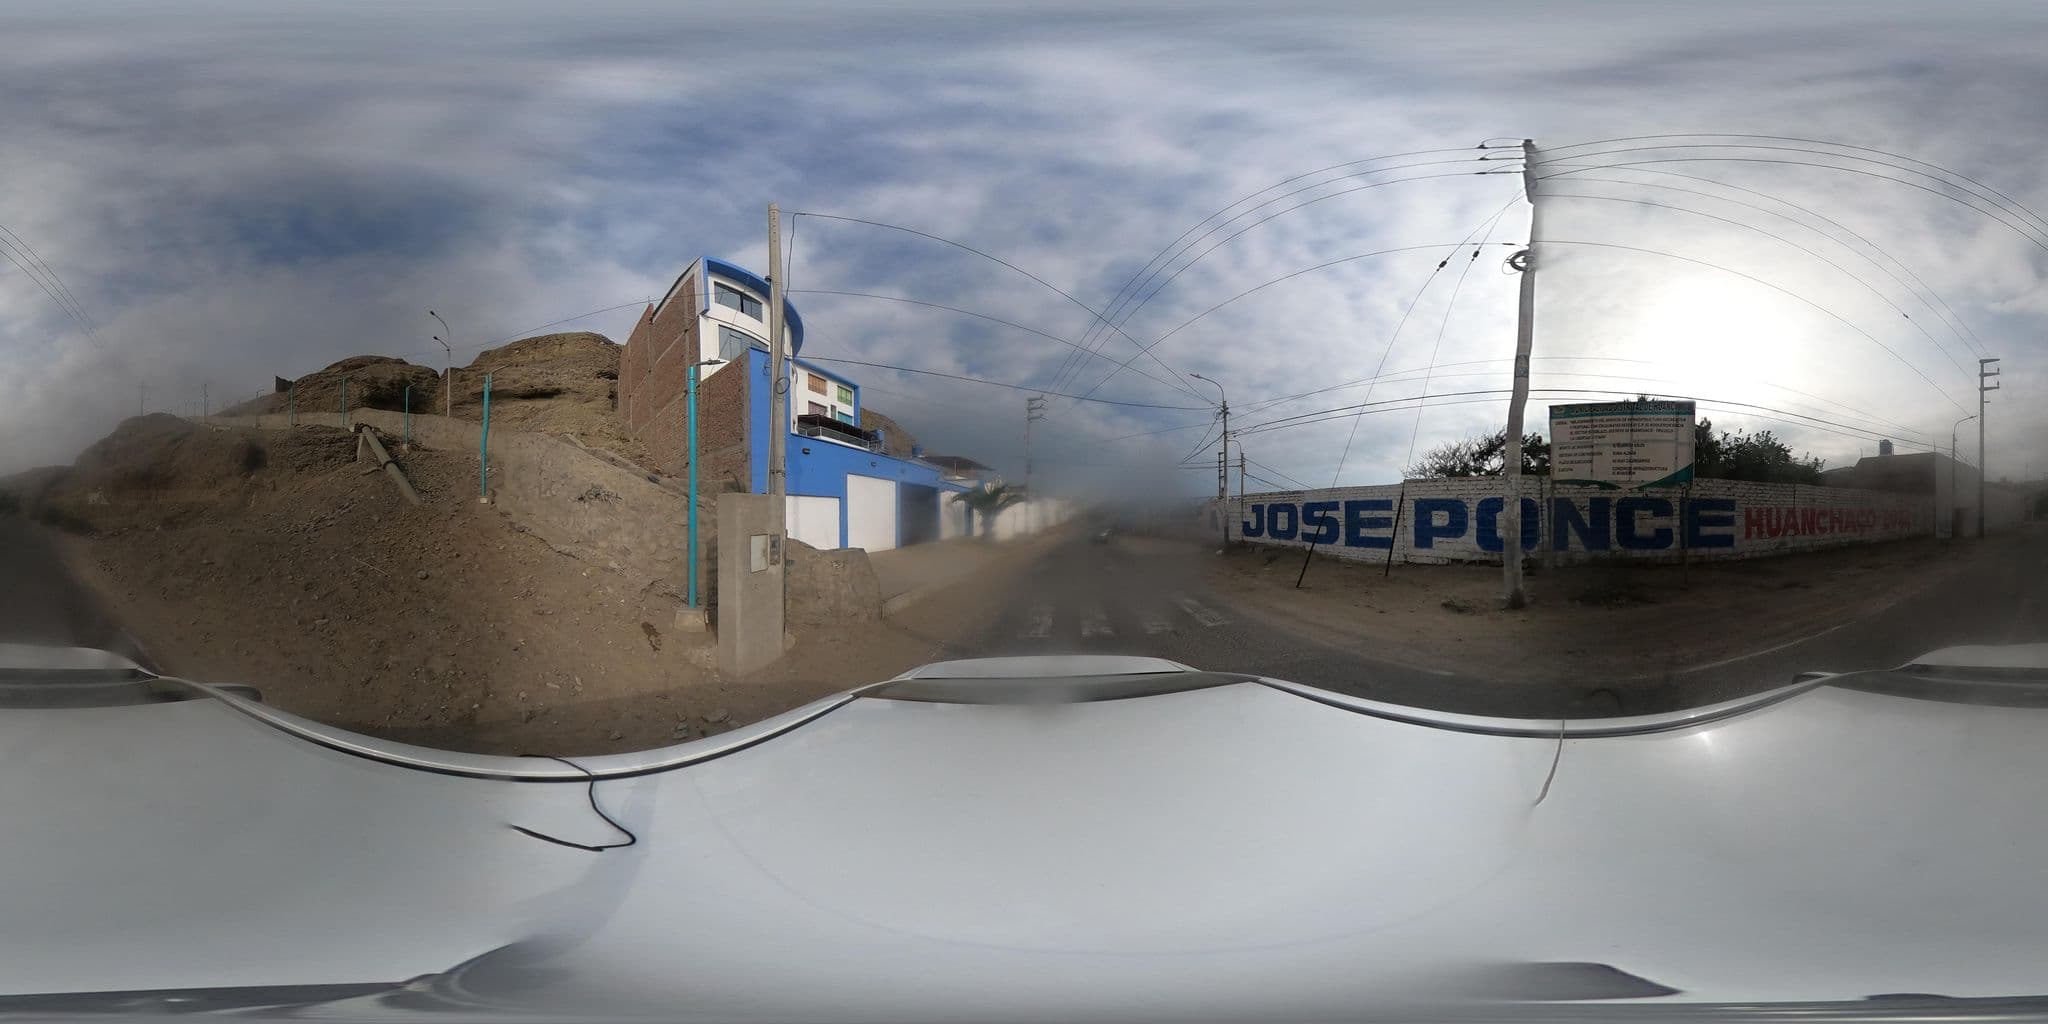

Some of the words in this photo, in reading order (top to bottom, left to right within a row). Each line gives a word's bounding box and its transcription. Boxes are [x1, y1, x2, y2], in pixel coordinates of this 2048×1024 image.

[1242, 500, 1393, 548] JOSE
[1414, 497, 1736, 552] PONCE
[1745, 506, 1875, 540] HUANCHACO
